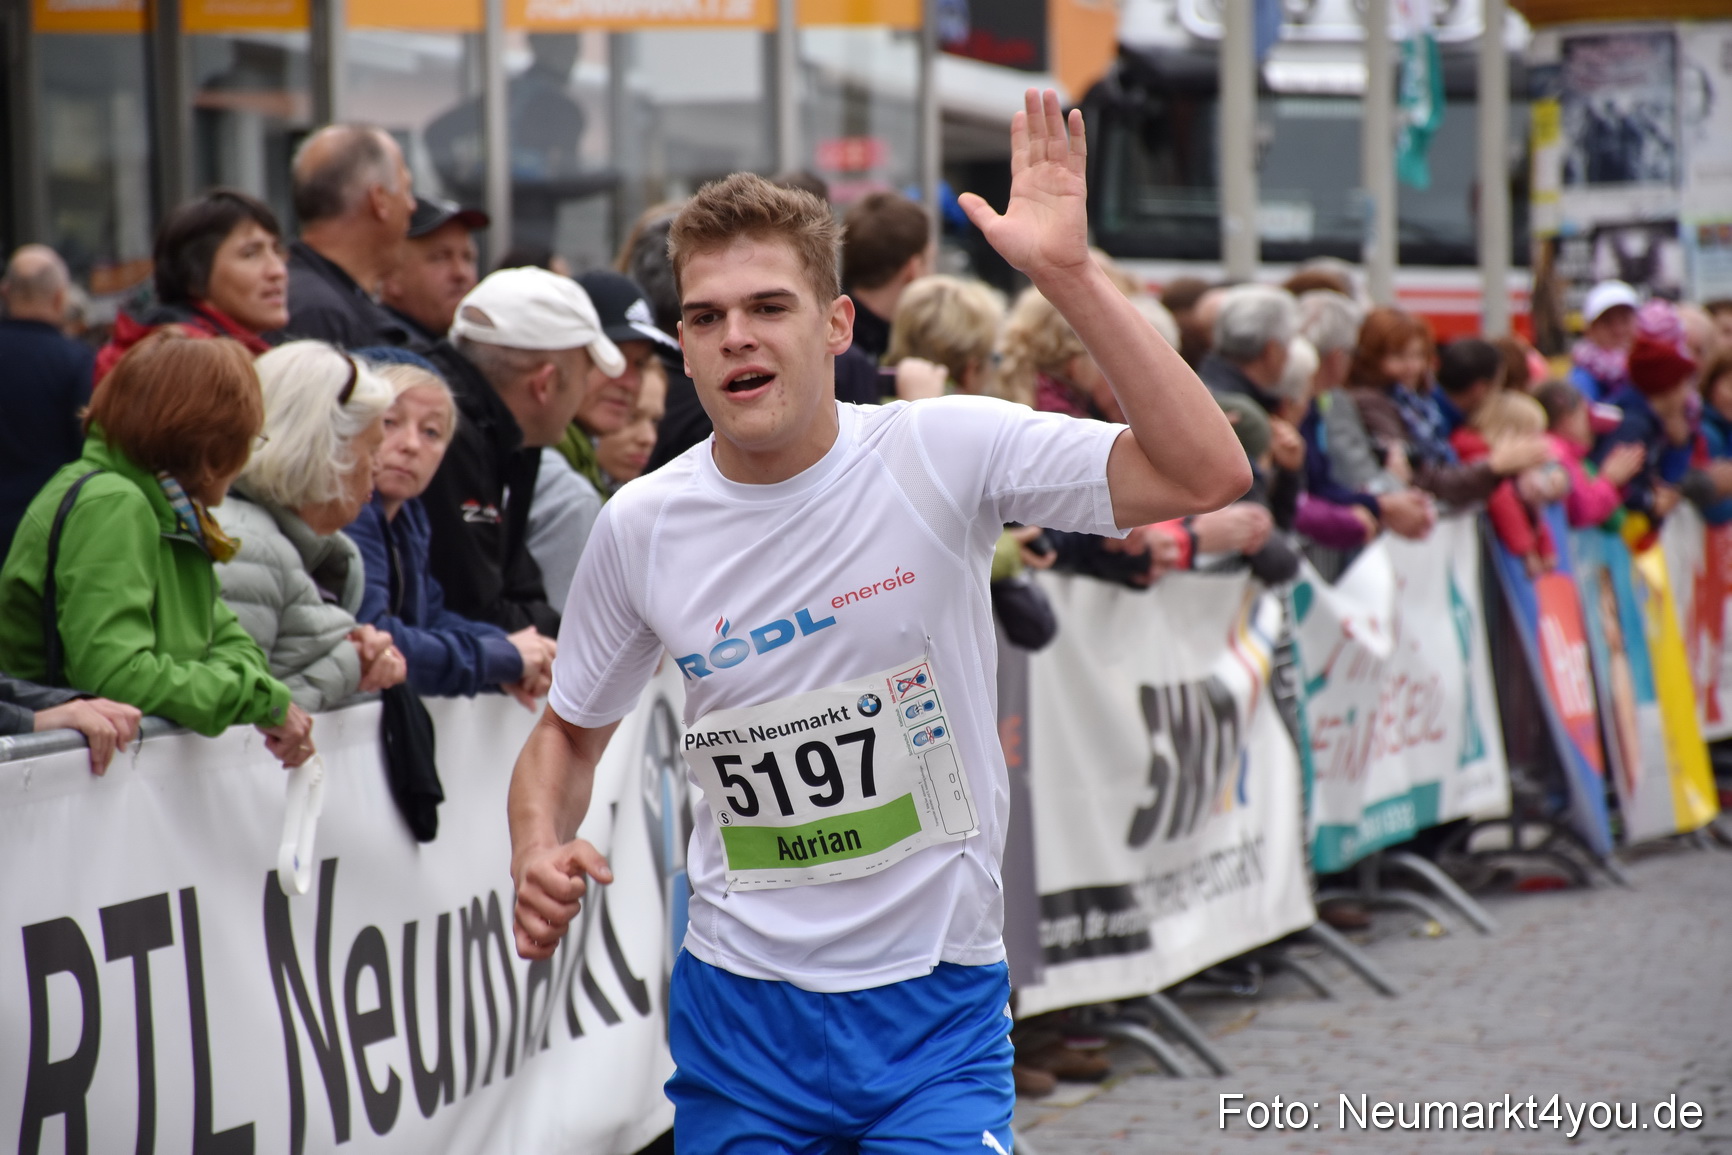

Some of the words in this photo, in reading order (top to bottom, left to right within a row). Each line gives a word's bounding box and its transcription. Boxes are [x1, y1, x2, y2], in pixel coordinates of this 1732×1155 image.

[684, 729, 748, 751] PARTL
[748, 705, 852, 744] Neumarkt
[711, 727, 876, 818] 5197
[721, 812, 730, 825] S
[776, 829, 863, 862] Adrian
